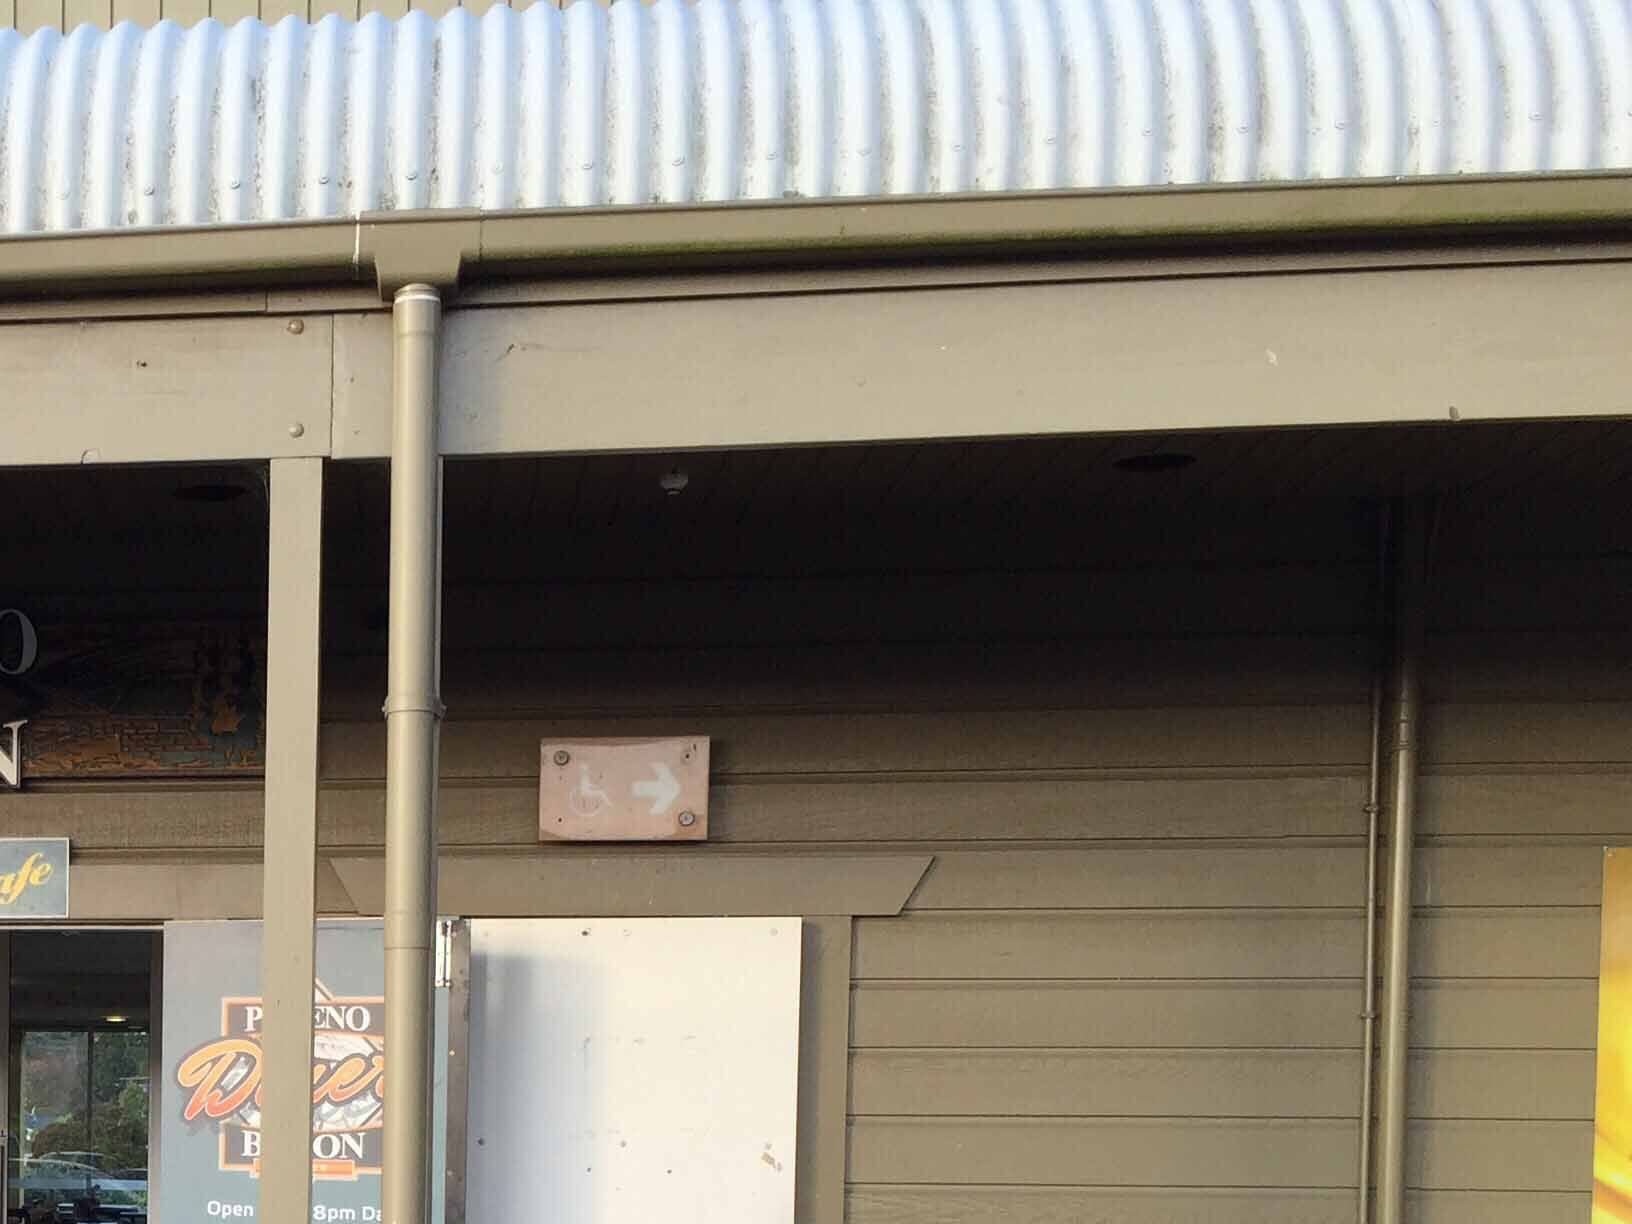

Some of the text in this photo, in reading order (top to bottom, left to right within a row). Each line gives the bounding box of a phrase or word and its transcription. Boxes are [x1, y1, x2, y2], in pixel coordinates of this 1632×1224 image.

[244, 1006, 370, 1032] PENO
[241, 1131, 366, 1158] BON
[207, 1201, 254, 1218] Open
[313, 1205, 356, 1222] 8pm
